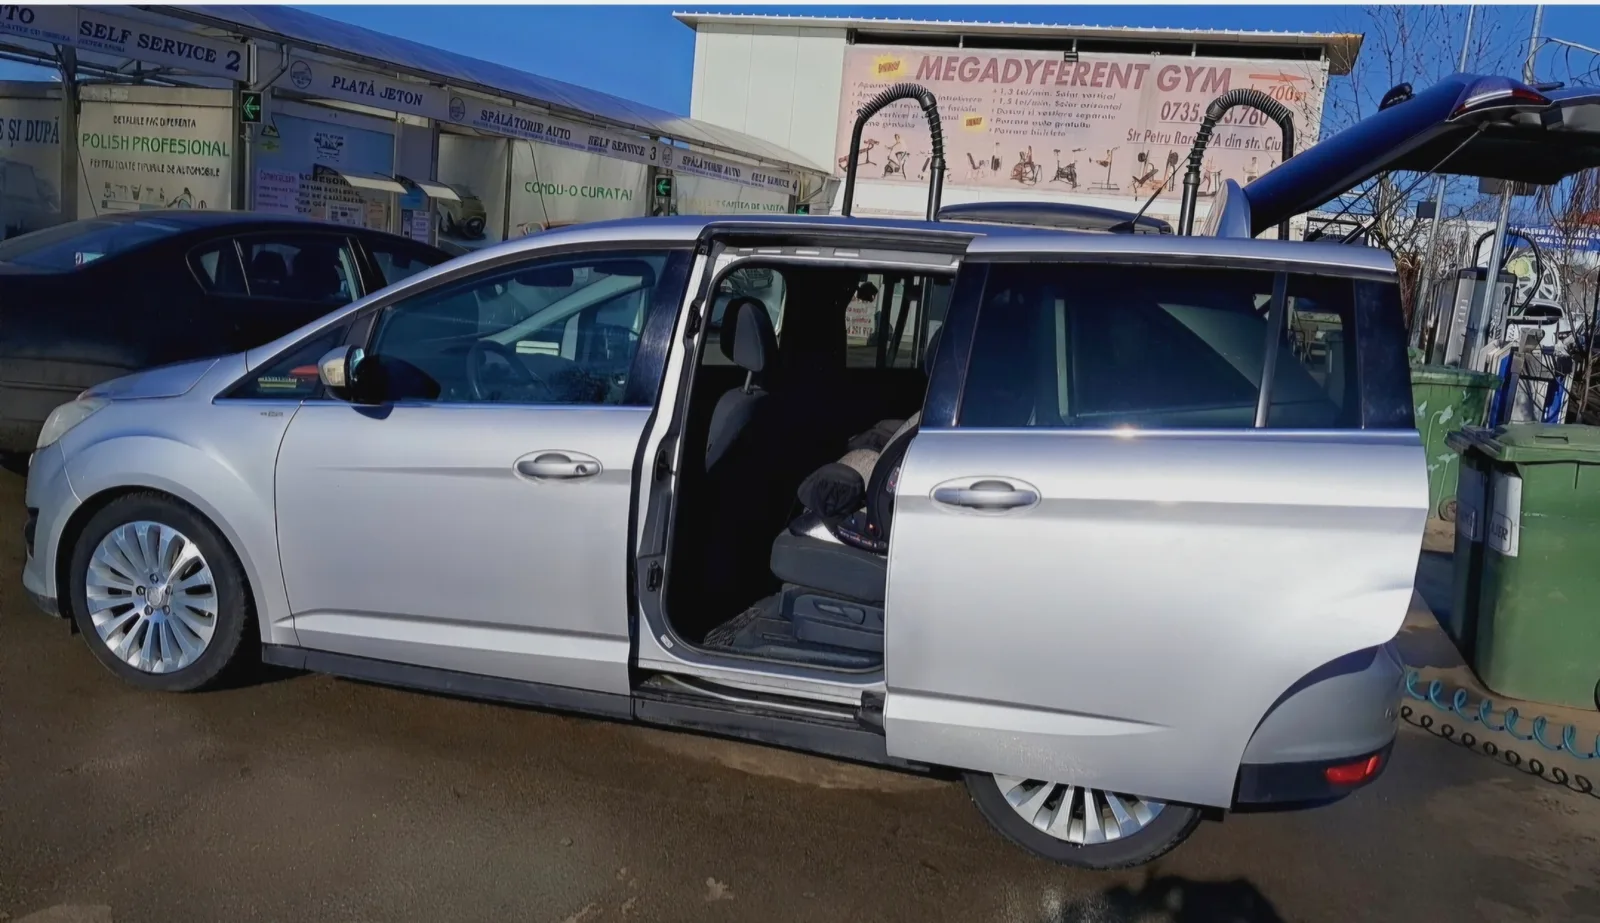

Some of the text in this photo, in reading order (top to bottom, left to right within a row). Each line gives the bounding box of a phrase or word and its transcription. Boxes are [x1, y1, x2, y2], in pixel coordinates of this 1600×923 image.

[0, 5, 35, 24] TO
[79, 20, 132, 44] SELF
[137, 33, 217, 63] SERVICE
[225, 50, 241, 72] 2
[916, 54, 1232, 94] MEGADYFERENT GYM
[331, 75, 424, 106] PLATĂ JETON
[25, 115, 60, 144] DUPĂ
[545, 125, 571, 140] AUTO
[649, 147, 657, 161] 3
[1144, 129, 1171, 143] Petru
[1225, 134, 1242, 148] din
[82, 133, 230, 157] POLISH PROFESIONAL
[524, 181, 578, 197] CONDU-O
